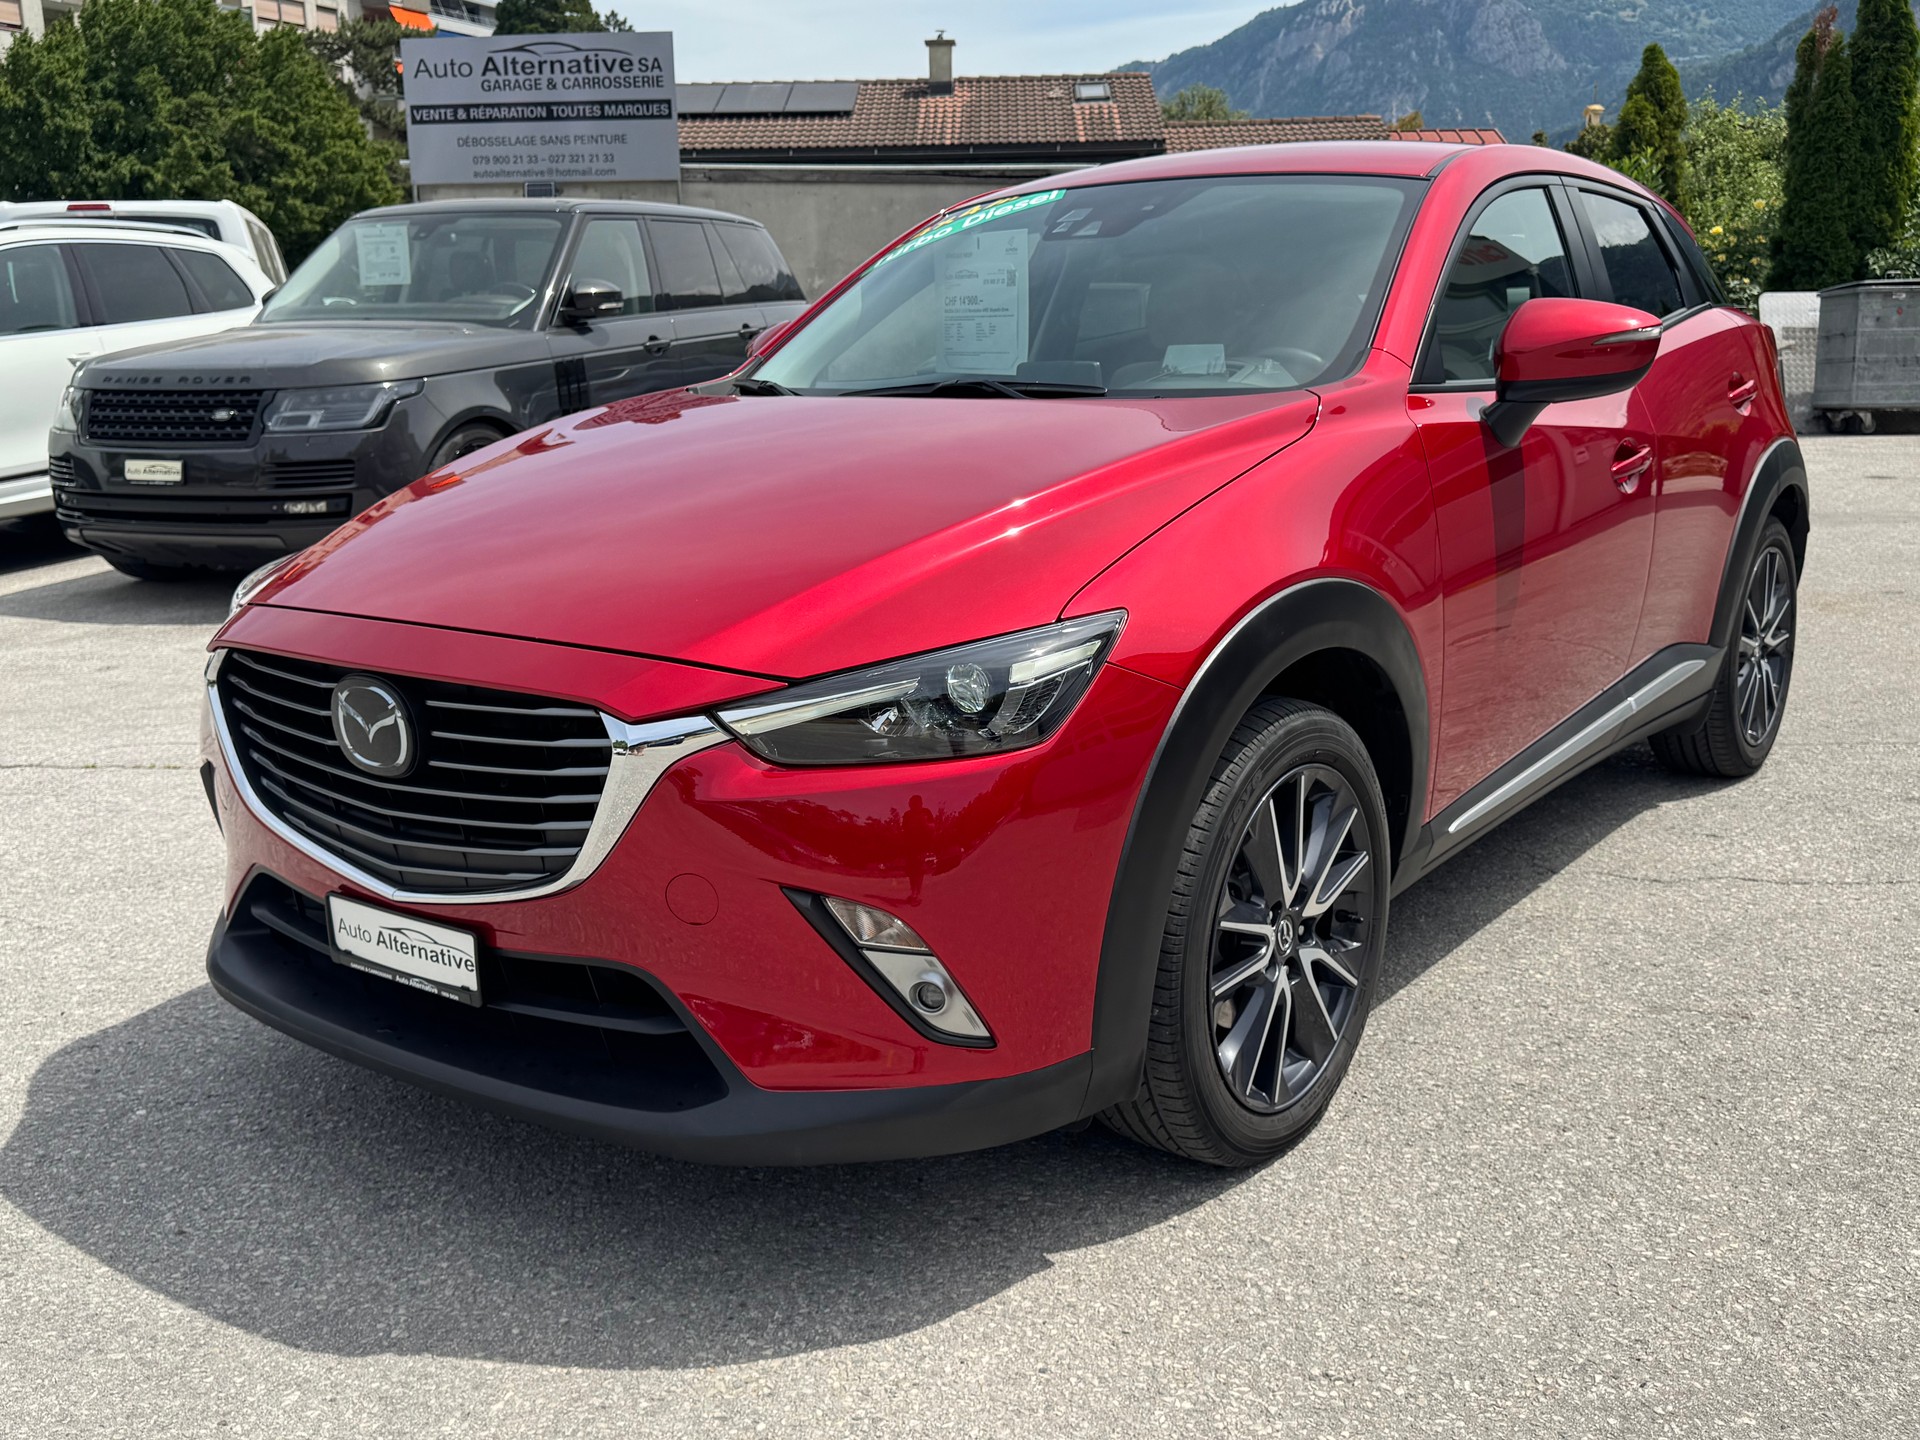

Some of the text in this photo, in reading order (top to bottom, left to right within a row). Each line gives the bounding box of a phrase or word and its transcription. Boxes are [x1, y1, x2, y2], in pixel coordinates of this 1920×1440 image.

[414, 53, 663, 78] Auto Alternative SA
[481, 75, 664, 92] GARAGE & CARROSSERIE
[413, 102, 670, 121] VENTE & RÉPARATION TOUTES MARQUES
[457, 133, 629, 148] DÉBOSSELAGE SANS PEINTURE
[472, 155, 490, 165] 079
[492, 155, 511, 165] 900
[513, 154, 524, 164] 21
[526, 154, 539, 164] 33
[548, 154, 566, 164] 027
[568, 153, 586, 163] 321
[588, 153, 600, 163] 21
[602, 152, 615, 163] 33
[473, 167, 617, 179] autoalternative@hotmail.com
[962, 189, 1059, 228] Diesel
[103, 376, 252, 384] RANGE ROVER
[338, 917, 372, 943] Auto
[376, 930, 476, 973] Alternative
